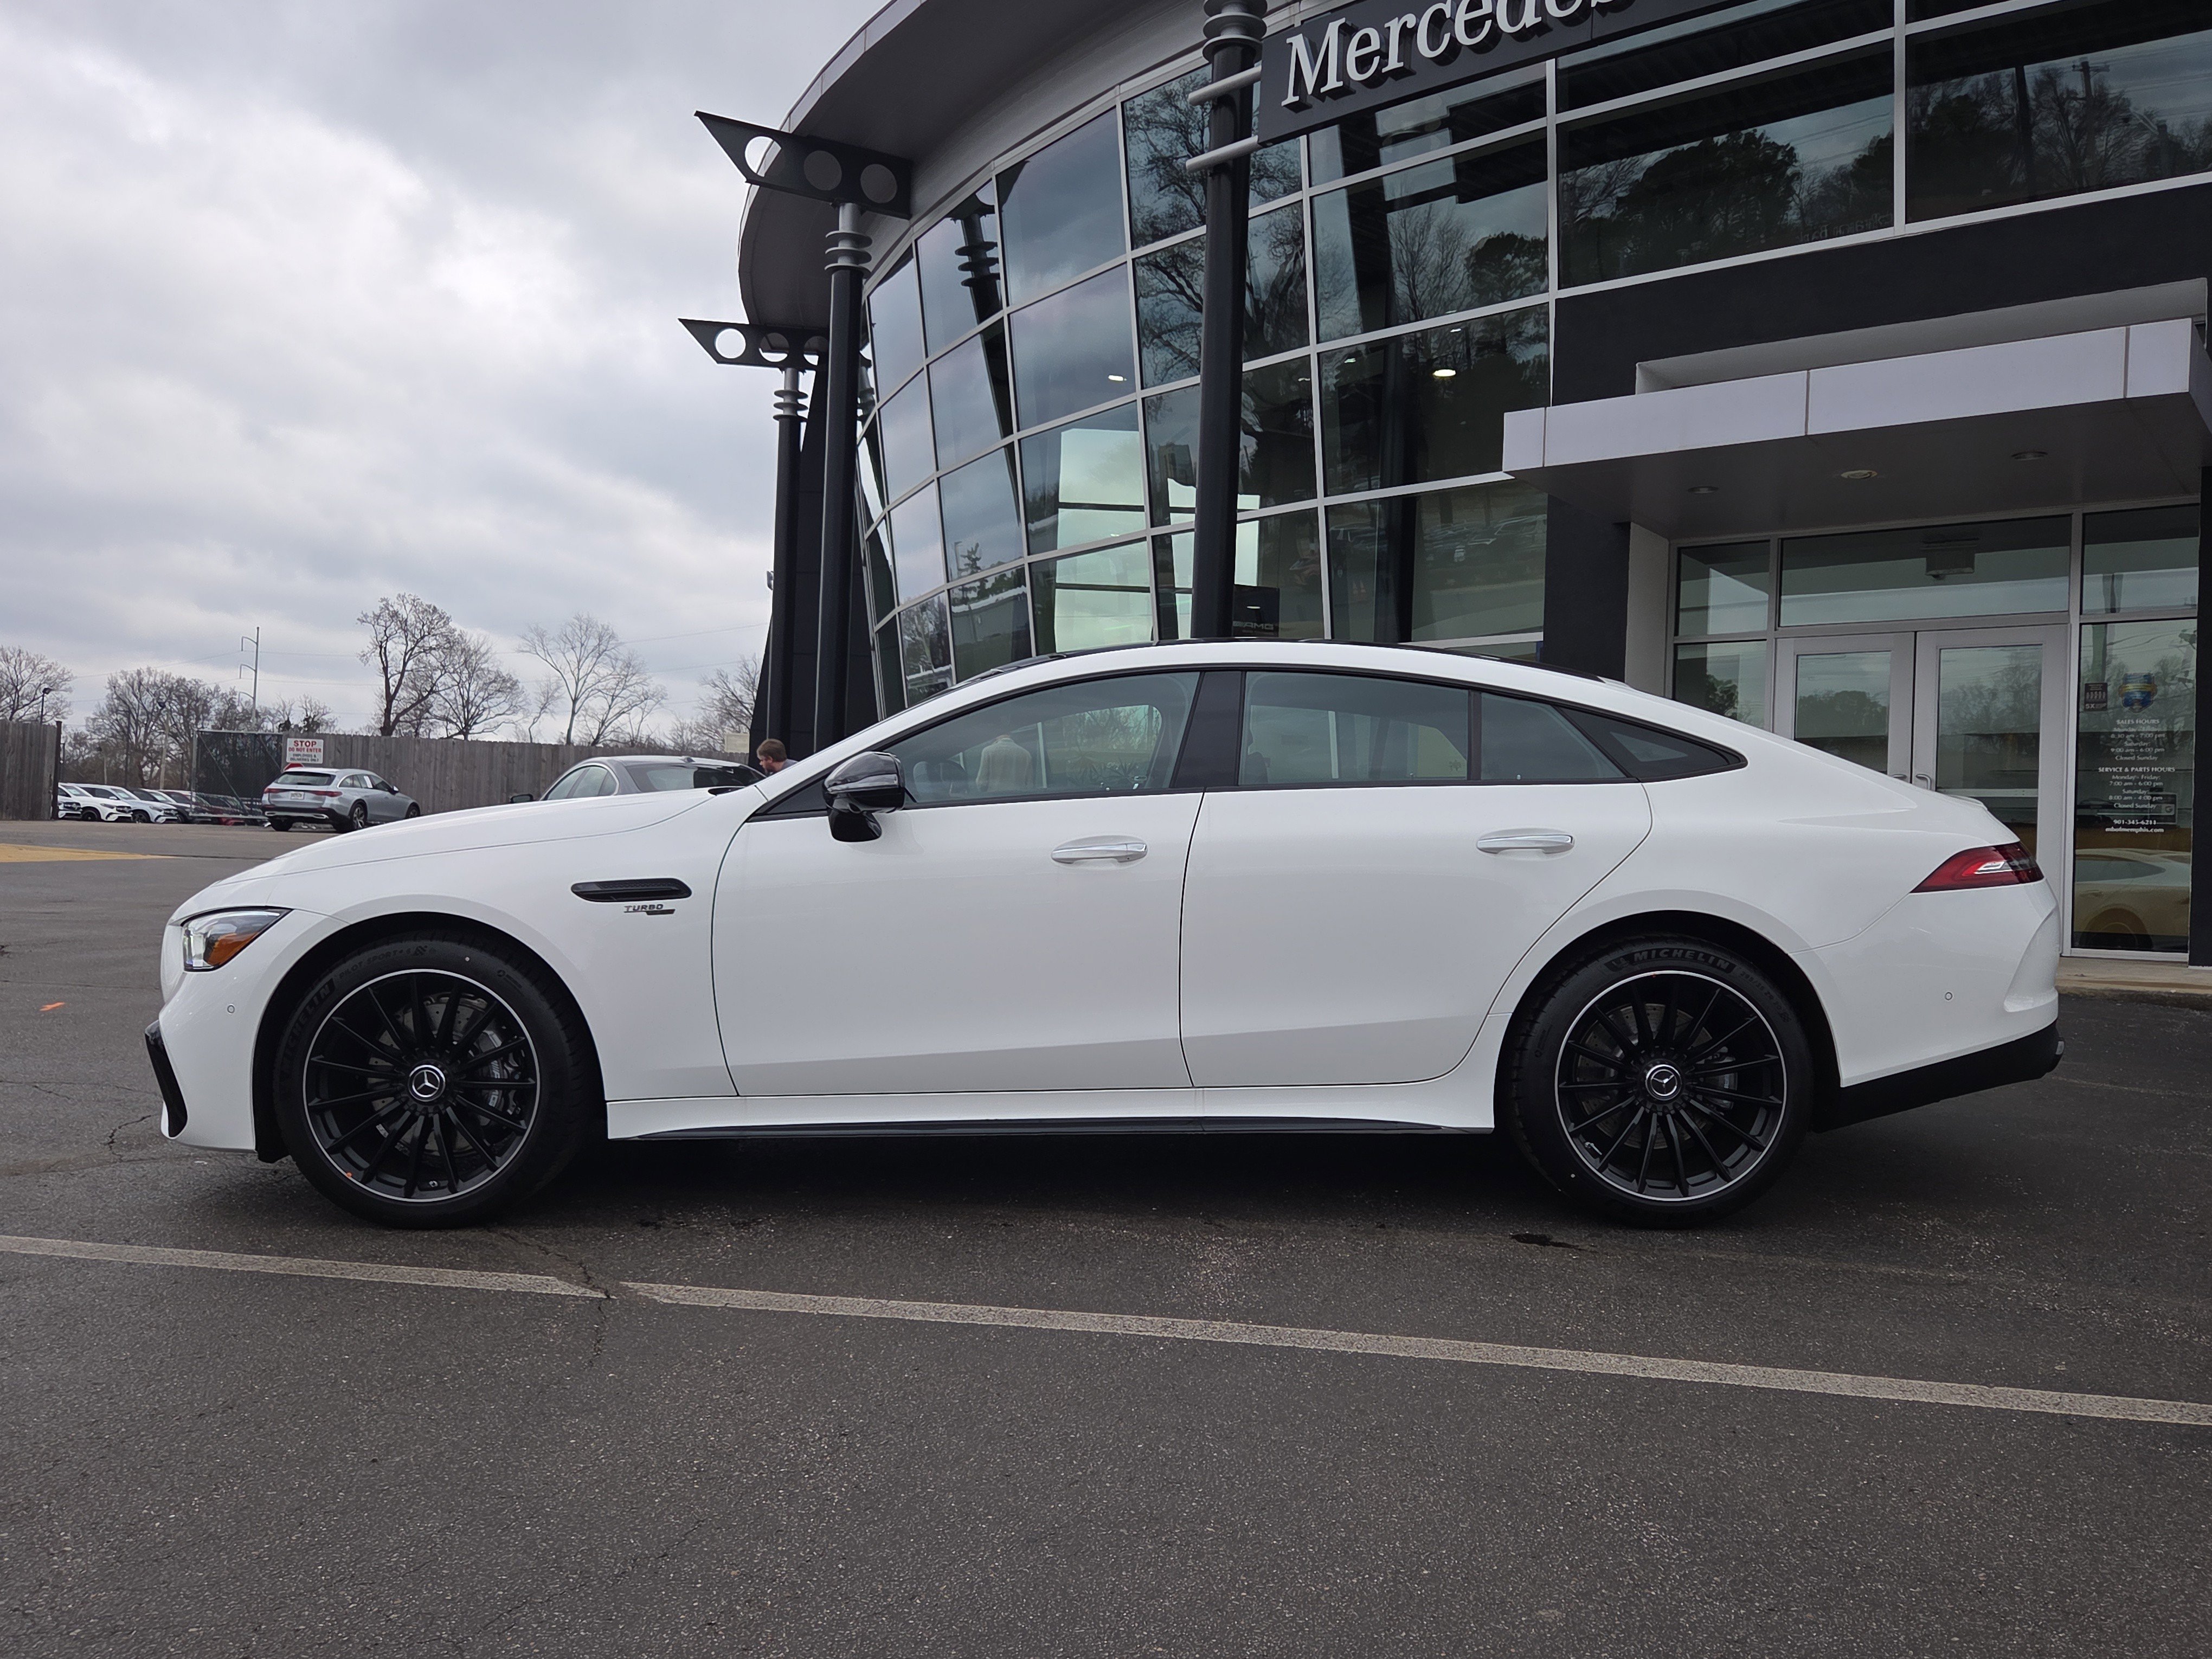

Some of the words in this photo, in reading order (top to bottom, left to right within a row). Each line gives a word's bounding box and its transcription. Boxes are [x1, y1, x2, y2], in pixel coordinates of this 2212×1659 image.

[1281, 0, 1613, 106] Merce
[1243, 622, 1274, 630] AMG
[339, 961, 363, 979] PILOT
[366, 949, 398, 965] SPORT
[1634, 948, 1730, 970] MICHELIN
